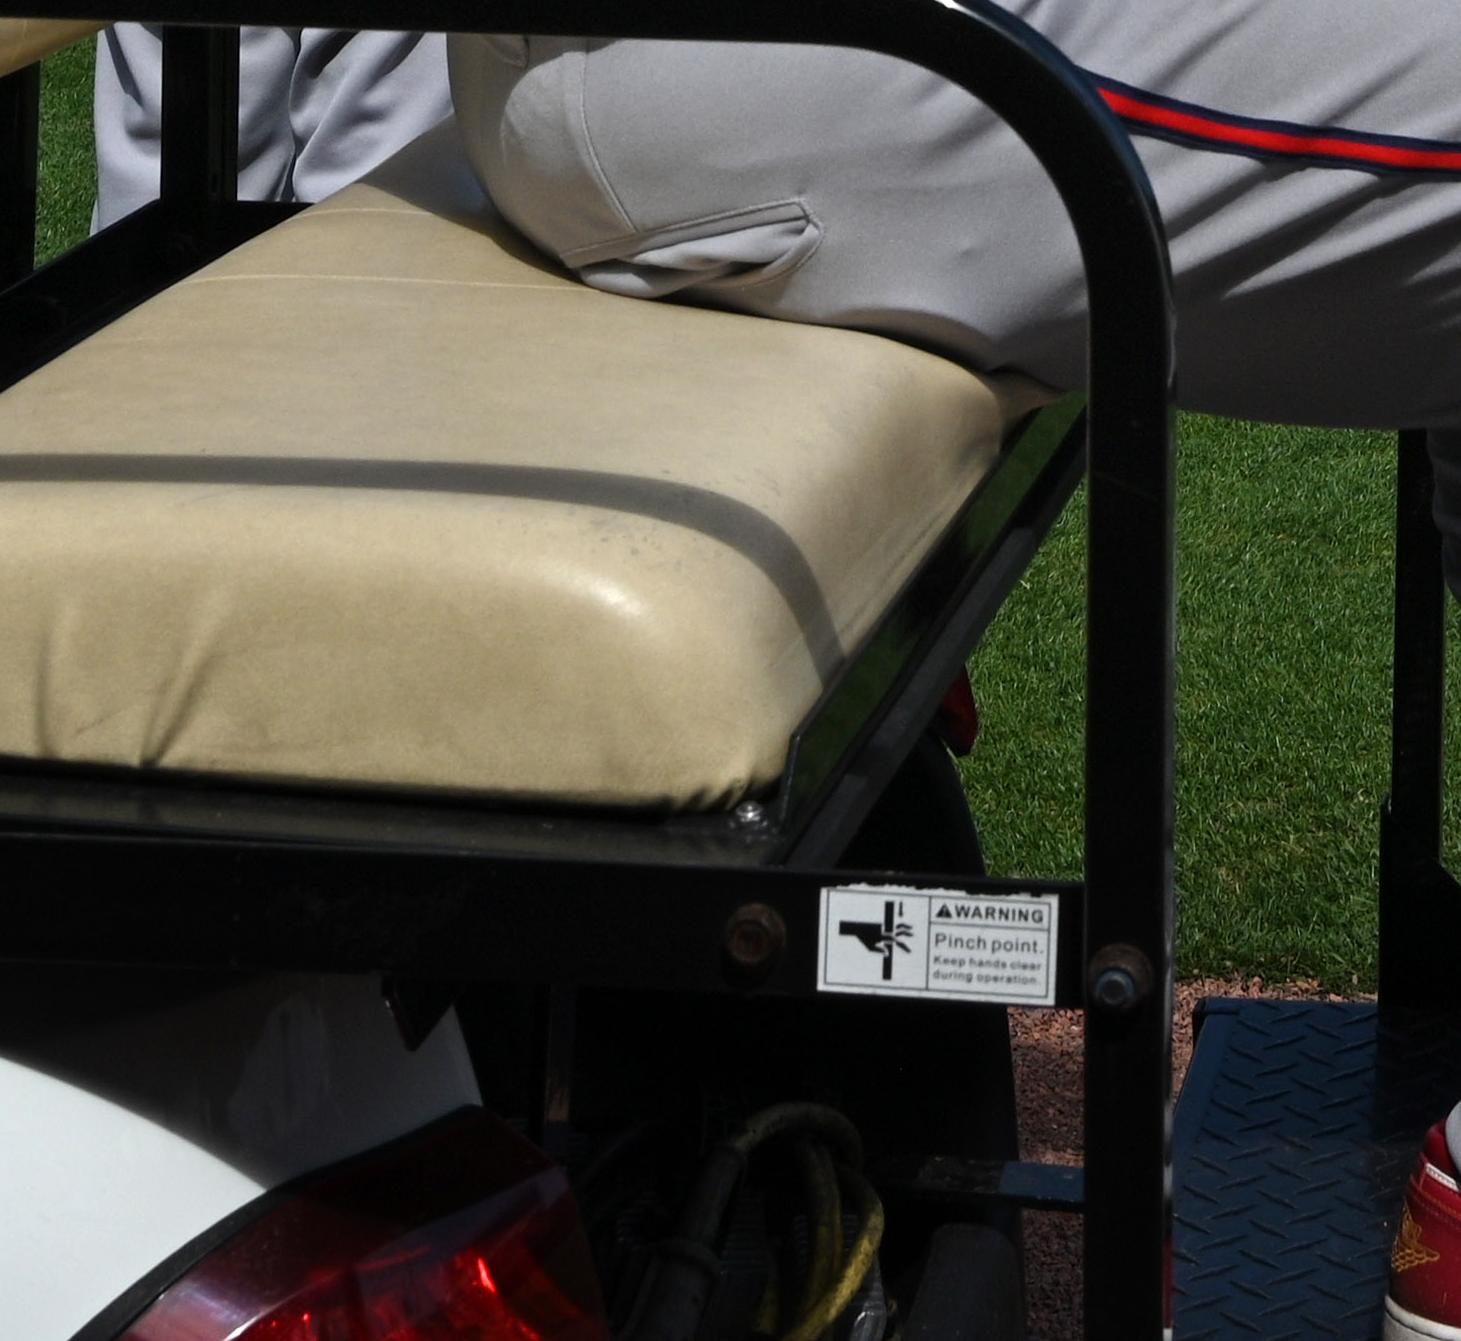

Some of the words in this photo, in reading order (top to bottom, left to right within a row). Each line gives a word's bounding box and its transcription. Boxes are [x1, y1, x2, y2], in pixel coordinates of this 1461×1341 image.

[955, 904, 1043, 924] WARNING
[935, 932, 987, 950] Pinch
[992, 937, 1044, 954] point.
[933, 955, 966, 968] Keep
[969, 957, 1007, 969] hands
[1010, 960, 1041, 970] clear
[933, 970, 972, 983] during
